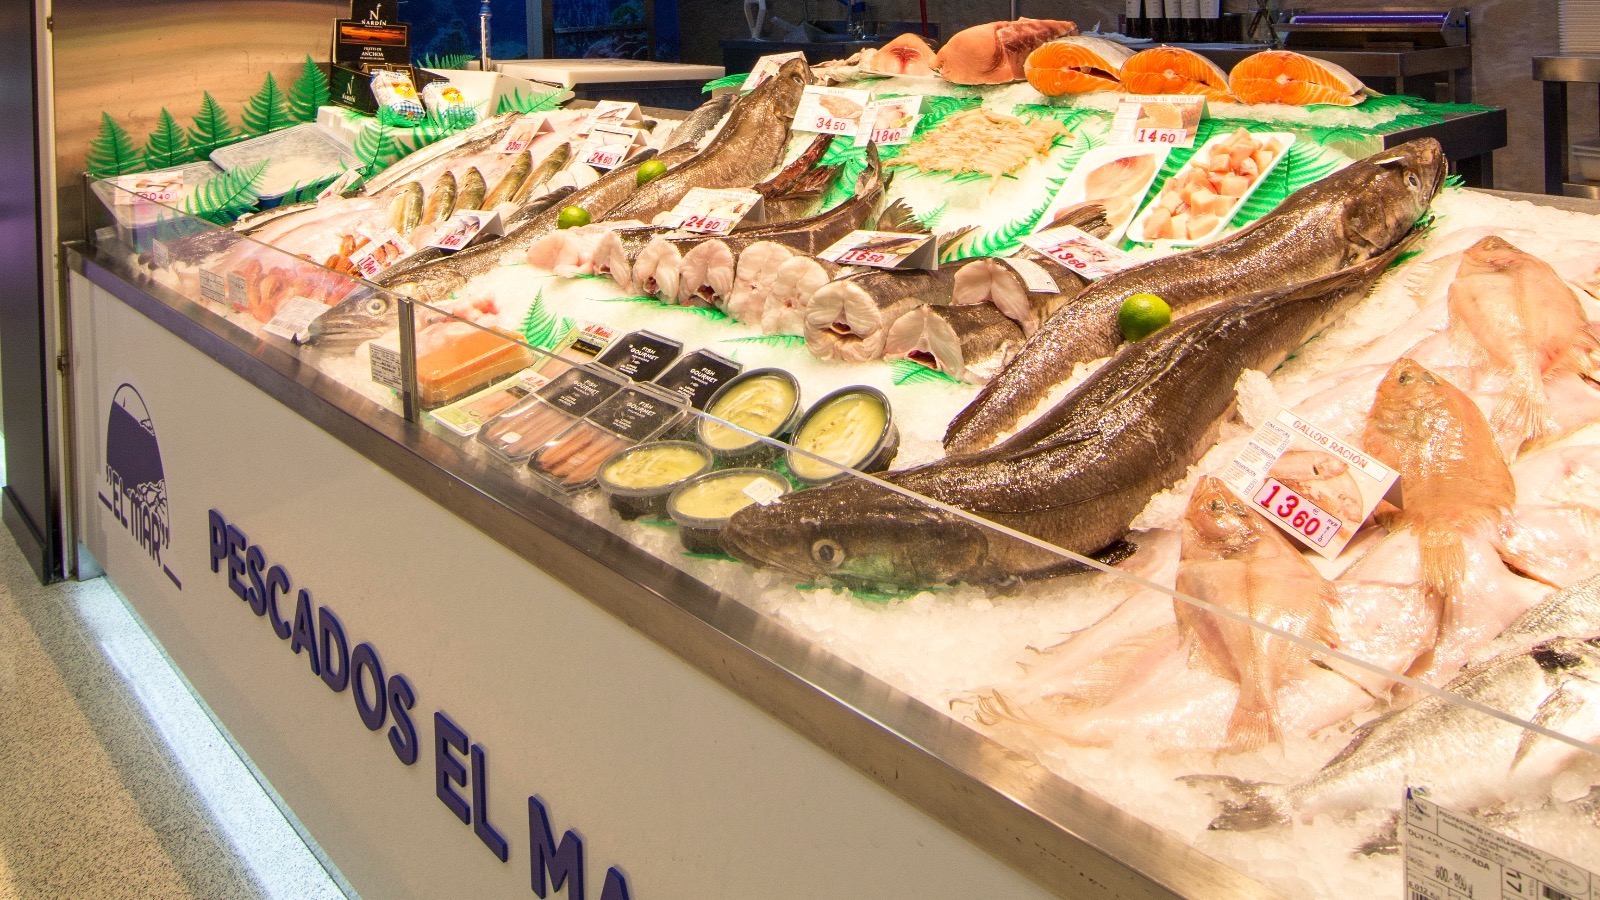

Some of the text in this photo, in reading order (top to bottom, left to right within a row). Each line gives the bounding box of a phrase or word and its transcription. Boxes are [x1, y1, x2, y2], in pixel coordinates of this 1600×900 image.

[630, 347, 659, 361] GOURMET
[641, 346, 657, 355] FISH
[690, 368, 718, 383] GOURMET
[701, 367, 716, 376] FISH
[573, 380, 600, 396] GOURMET
[584, 379, 598, 389] FISH
[627, 402, 656, 417] GOURMET
[639, 401, 654, 410] FISH
[1292, 420, 1331, 445] GALLOS
[208, 508, 419, 767] PESCADOS
[434, 711, 509, 864] EL
